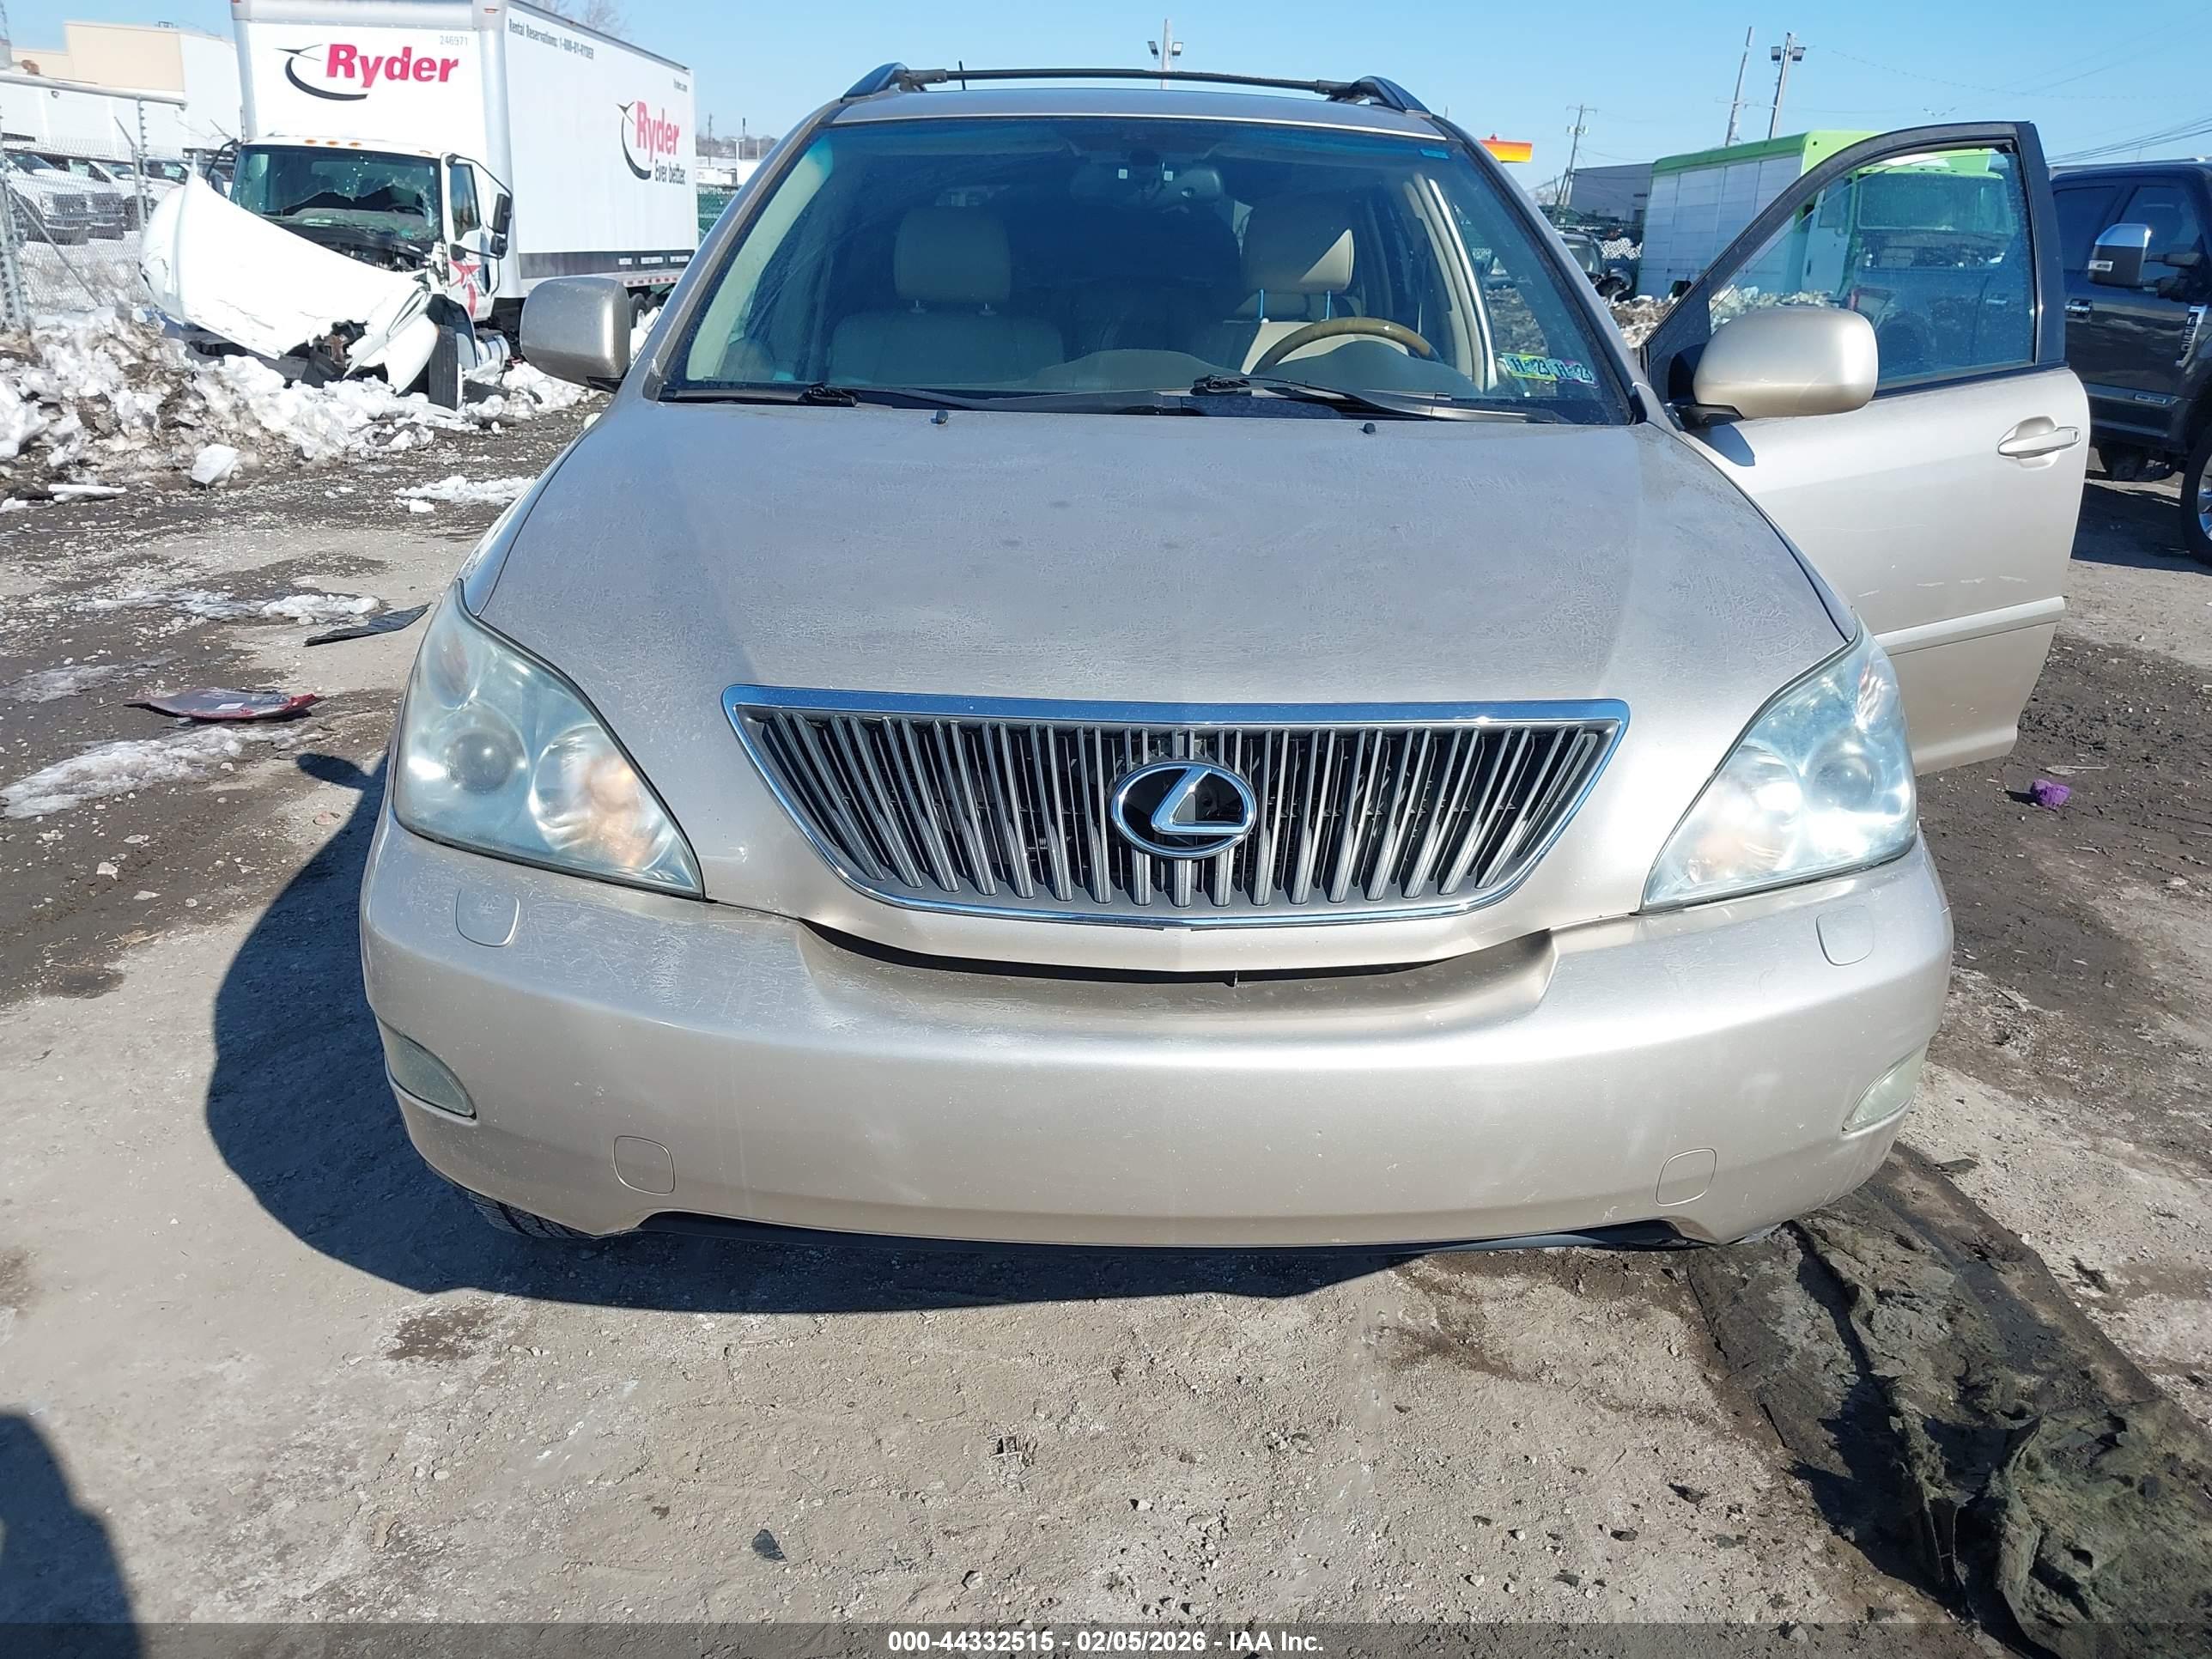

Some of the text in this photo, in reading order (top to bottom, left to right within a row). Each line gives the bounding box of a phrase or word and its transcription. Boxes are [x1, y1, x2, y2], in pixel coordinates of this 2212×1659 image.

[509, 18, 526, 36] Rental
[326, 44, 459, 88] Ryder
[637, 100, 680, 163] Ryder
[655, 158, 667, 182] Ever
[1510, 358, 1551, 375] 11 23
